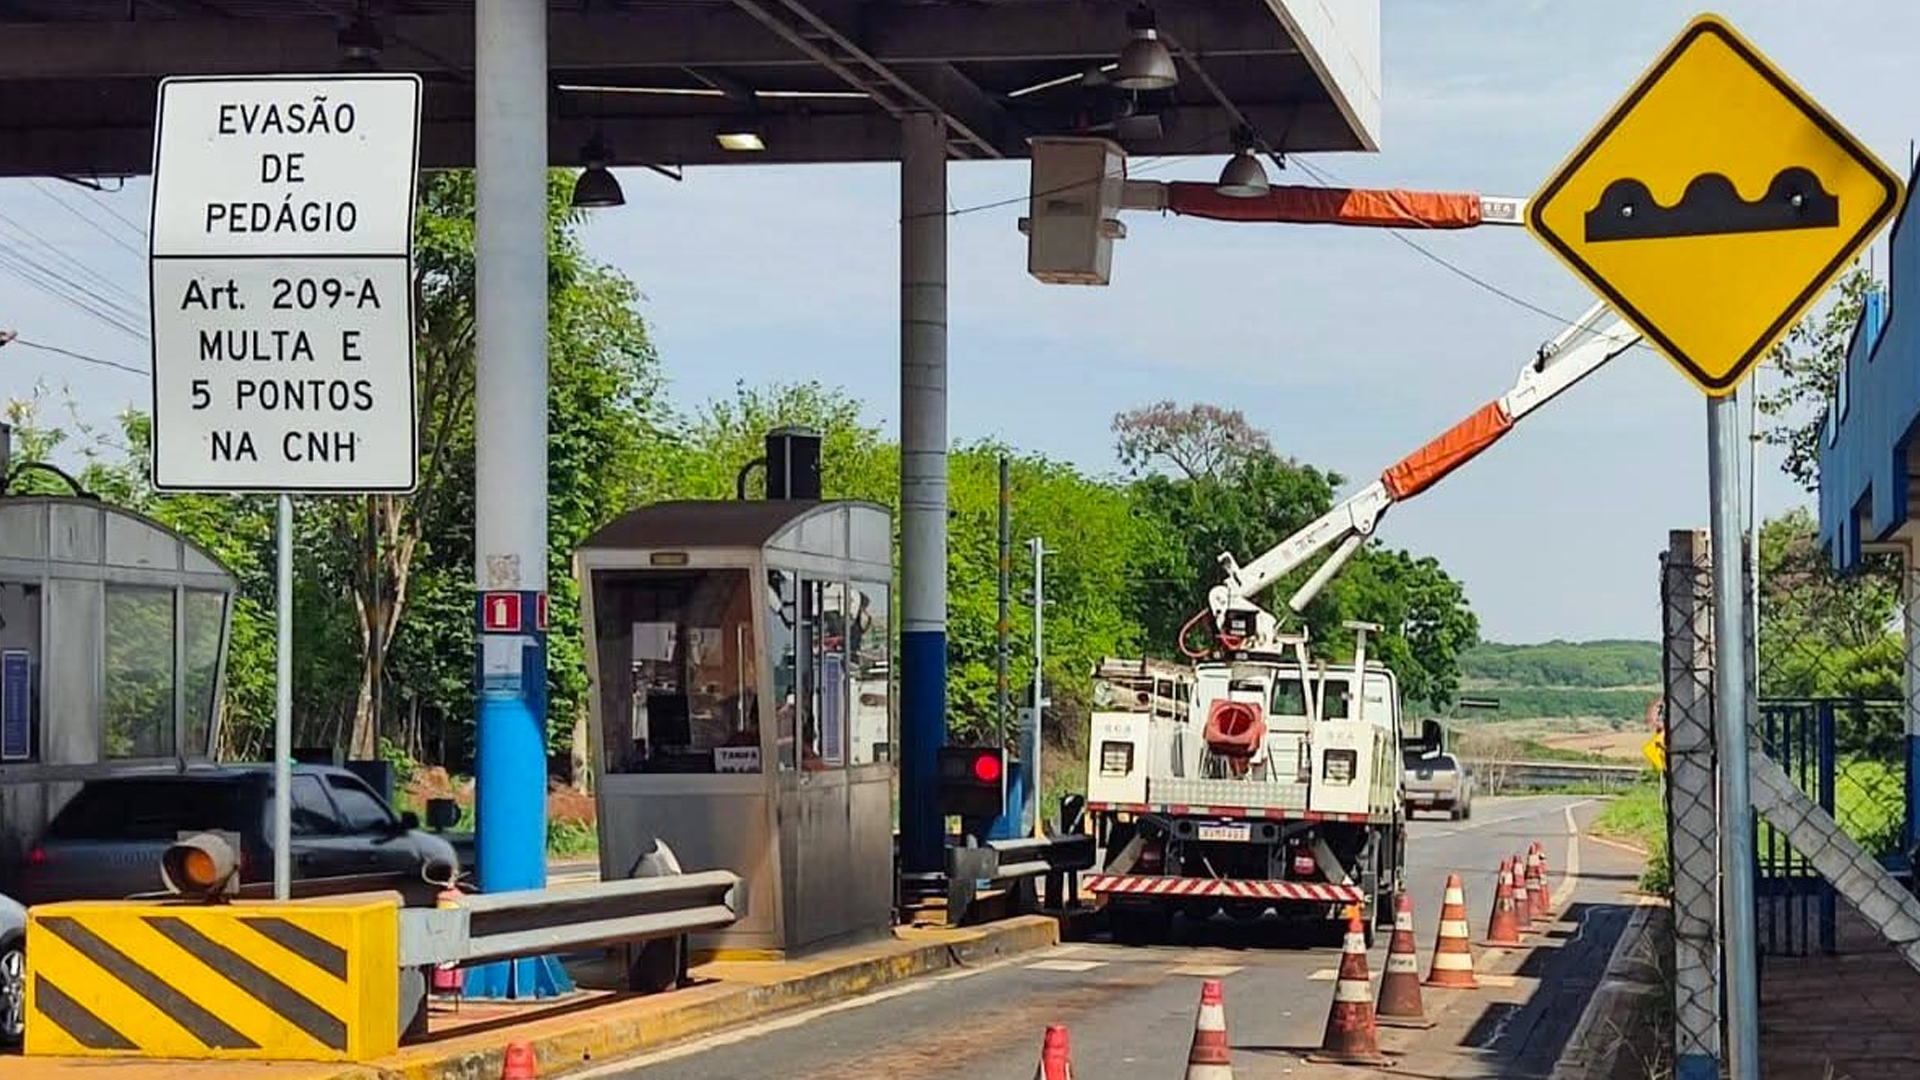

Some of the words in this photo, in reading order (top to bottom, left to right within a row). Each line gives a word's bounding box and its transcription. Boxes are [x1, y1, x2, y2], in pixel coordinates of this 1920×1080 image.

[219, 95, 355, 134] EVASÃO
[261, 153, 306, 184] DE
[206, 193, 357, 233] PEDÁGIO
[180, 279, 246, 310] Art.
[272, 278, 381, 310] 209-A
[199, 330, 314, 362] MULTA
[342, 330, 362, 362] E
[192, 379, 212, 411] 5
[236, 379, 374, 412] PONTOS
[211, 431, 258, 462] NA
[283, 431, 356, 463] CNH
